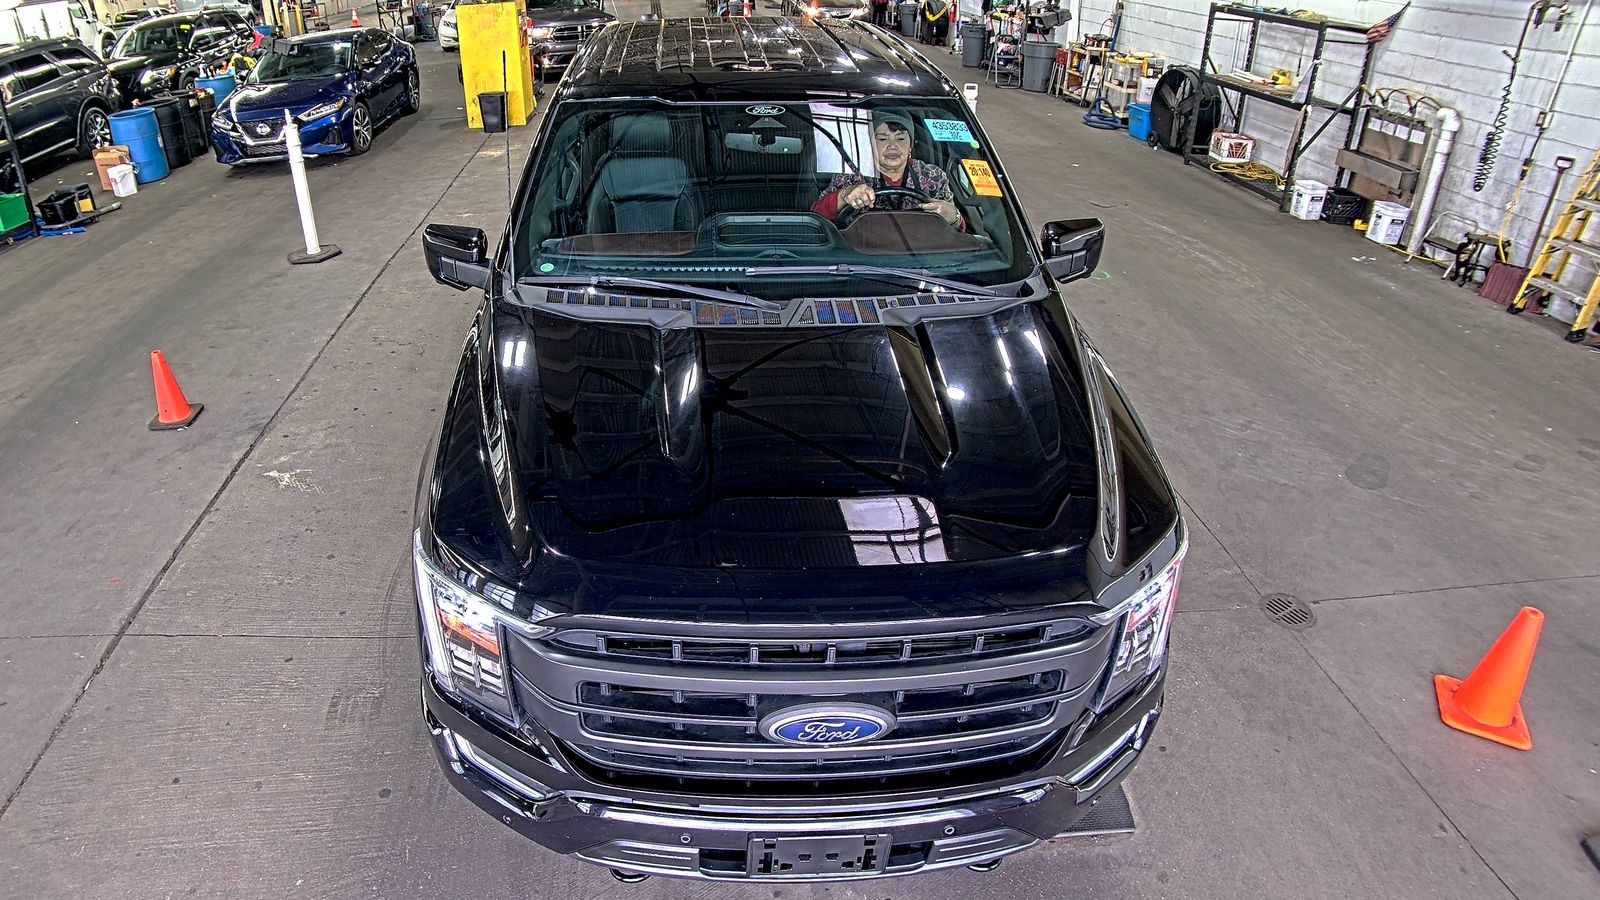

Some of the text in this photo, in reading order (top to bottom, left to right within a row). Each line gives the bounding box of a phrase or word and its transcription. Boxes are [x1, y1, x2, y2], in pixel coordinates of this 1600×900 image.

[753, 106, 779, 114] Ford
[932, 121, 968, 131] 4353833
[798, 721, 860, 741] Ford
